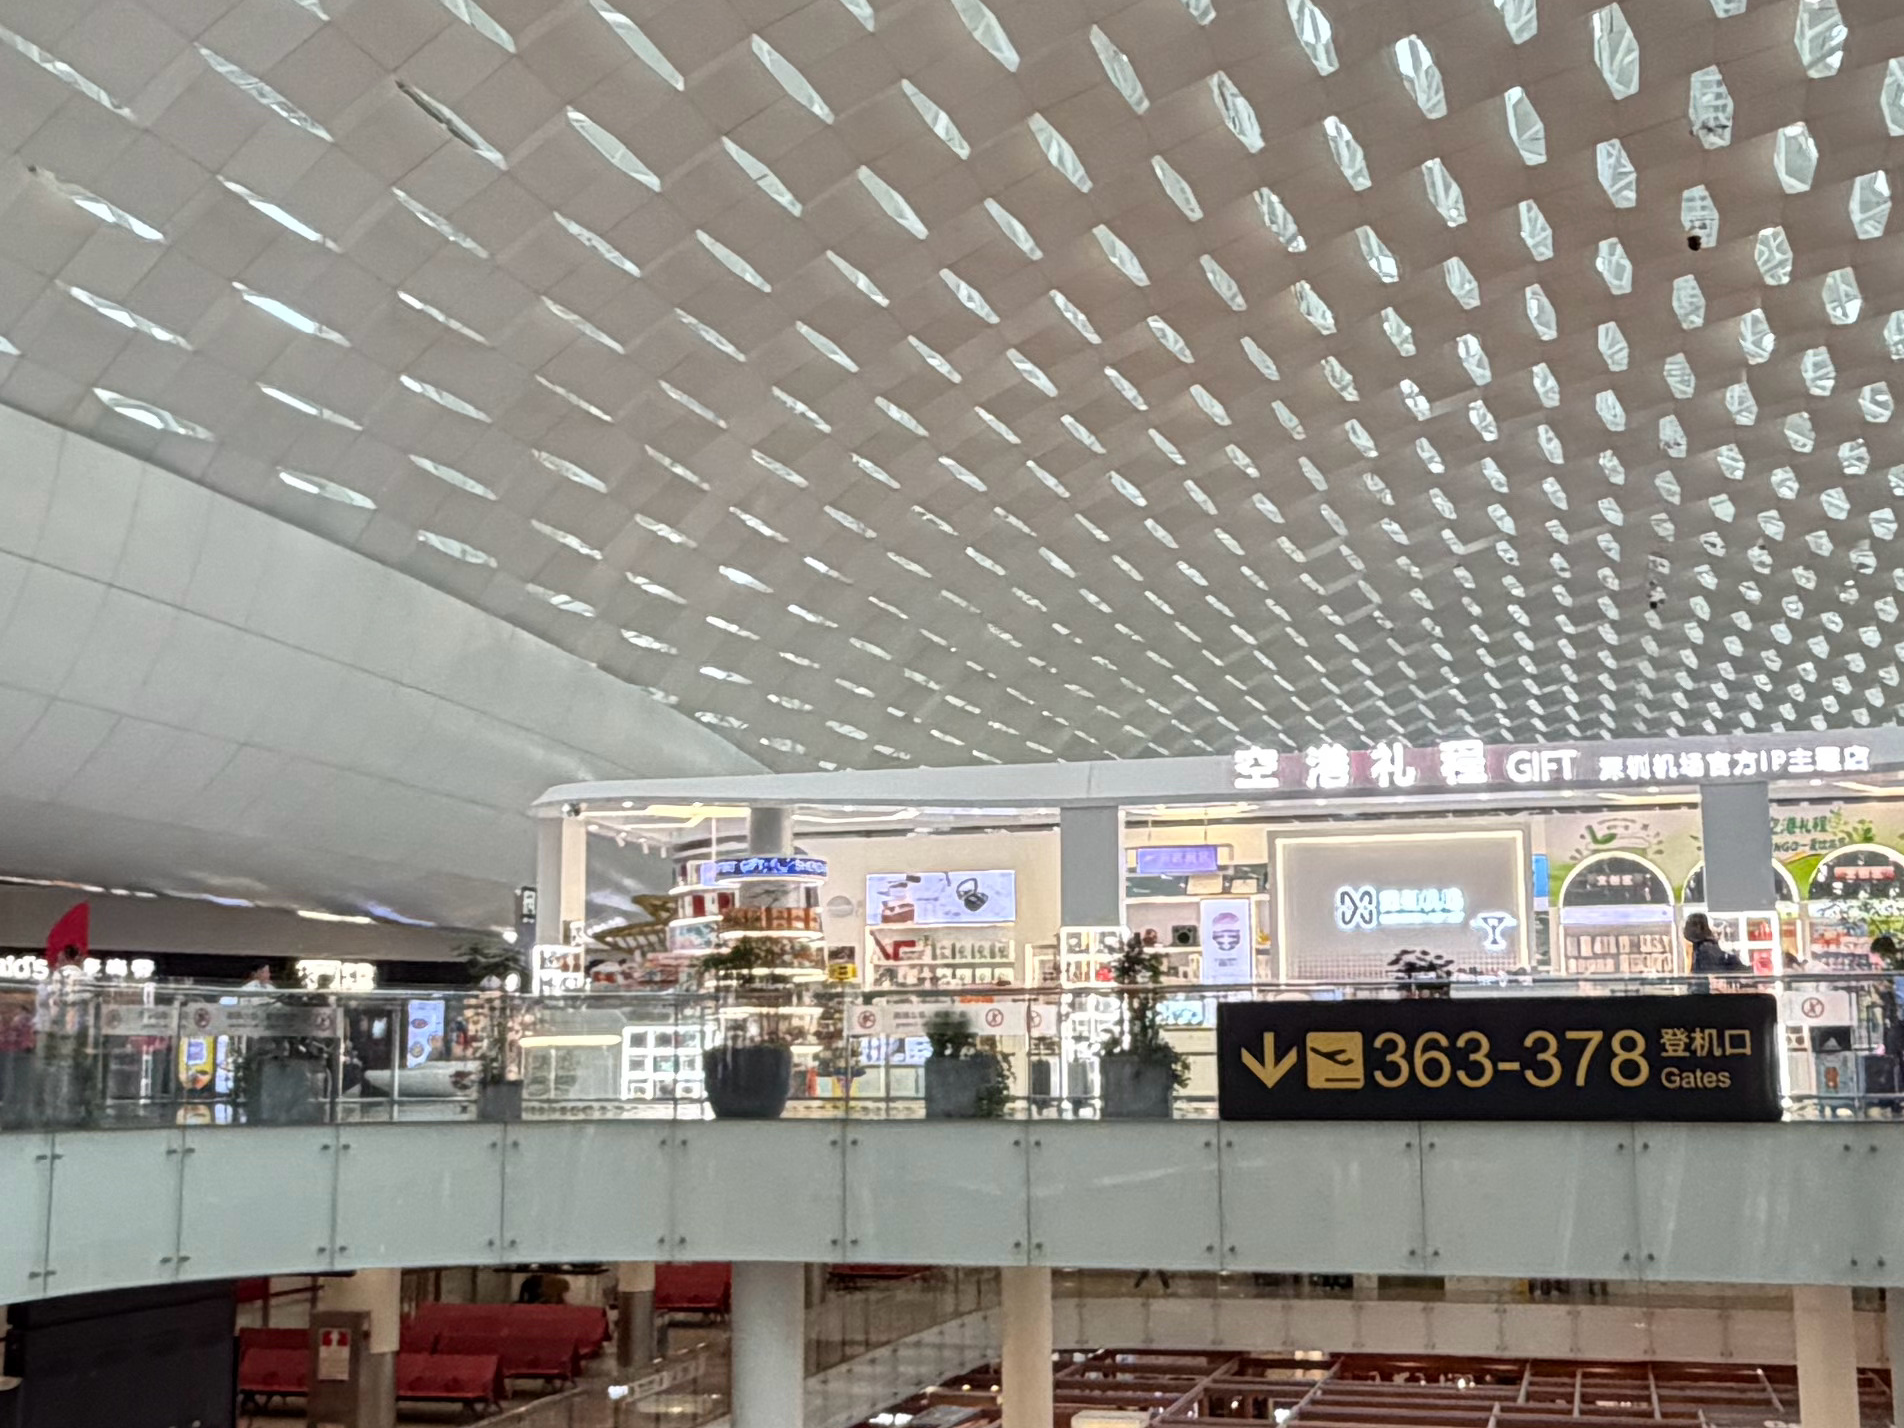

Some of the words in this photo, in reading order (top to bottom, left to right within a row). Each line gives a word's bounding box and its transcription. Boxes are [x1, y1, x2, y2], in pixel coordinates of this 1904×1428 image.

[1233, 739, 1488, 789] 空港礼程
[1506, 749, 1578, 783] GIFT
[1372, 1029, 1650, 1089] 363-378
[1660, 1027, 1752, 1058] 登机口
[1661, 1066, 1732, 1089] Gates
